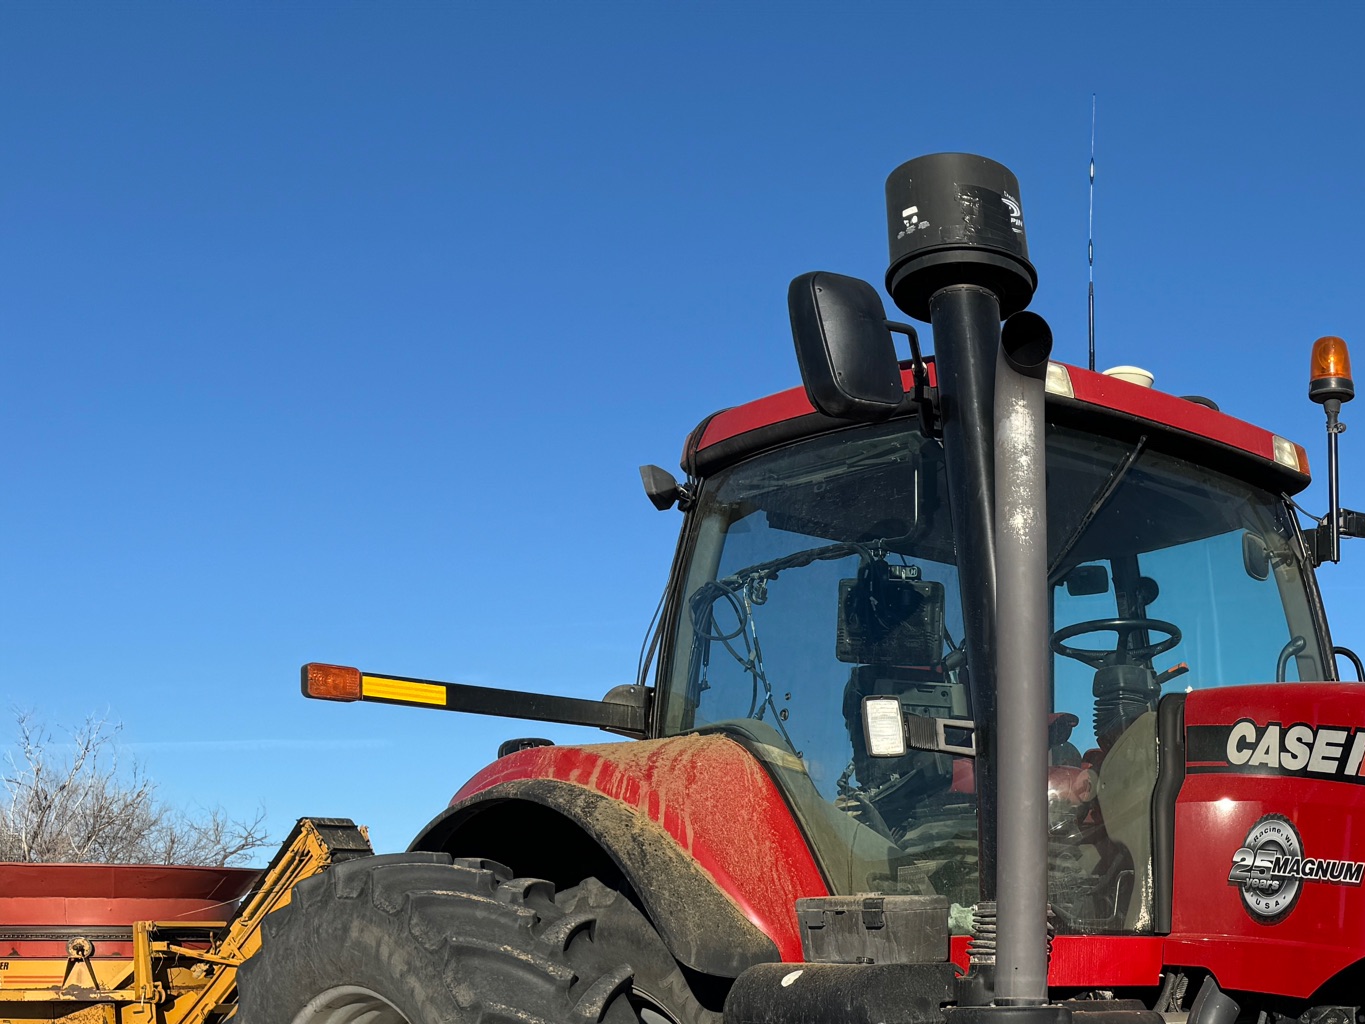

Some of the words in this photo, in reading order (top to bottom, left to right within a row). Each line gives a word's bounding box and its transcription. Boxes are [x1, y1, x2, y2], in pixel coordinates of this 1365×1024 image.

[1226, 721, 1348, 773] CASE
[1253, 825, 1284, 843] Racine,
[1229, 847, 1277, 882] 25
[1271, 856, 1365, 883] MAGNUM
[1246, 877, 1279, 890] years
[1255, 898, 1280, 909] USA
